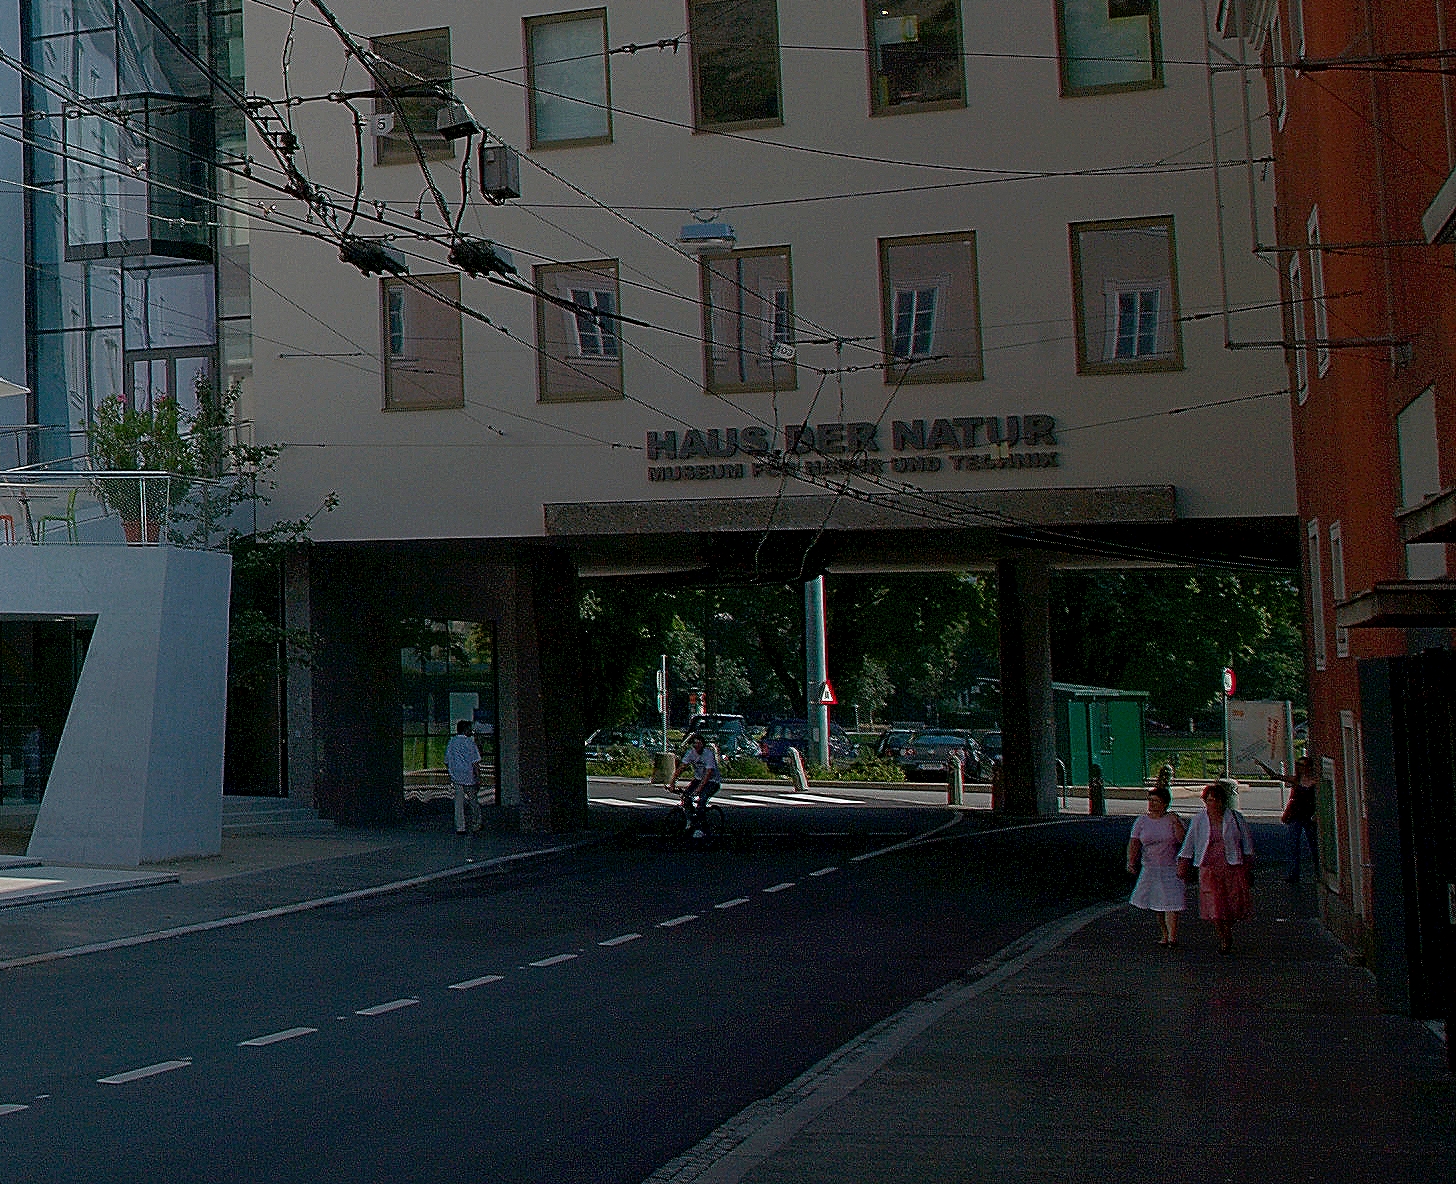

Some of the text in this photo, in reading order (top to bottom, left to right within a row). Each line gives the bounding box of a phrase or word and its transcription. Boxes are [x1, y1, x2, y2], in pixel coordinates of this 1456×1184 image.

[646, 414, 1059, 460] HAUS DER NATUR
[647, 462, 745, 483] MUSEUM
[890, 455, 942, 474] UND
